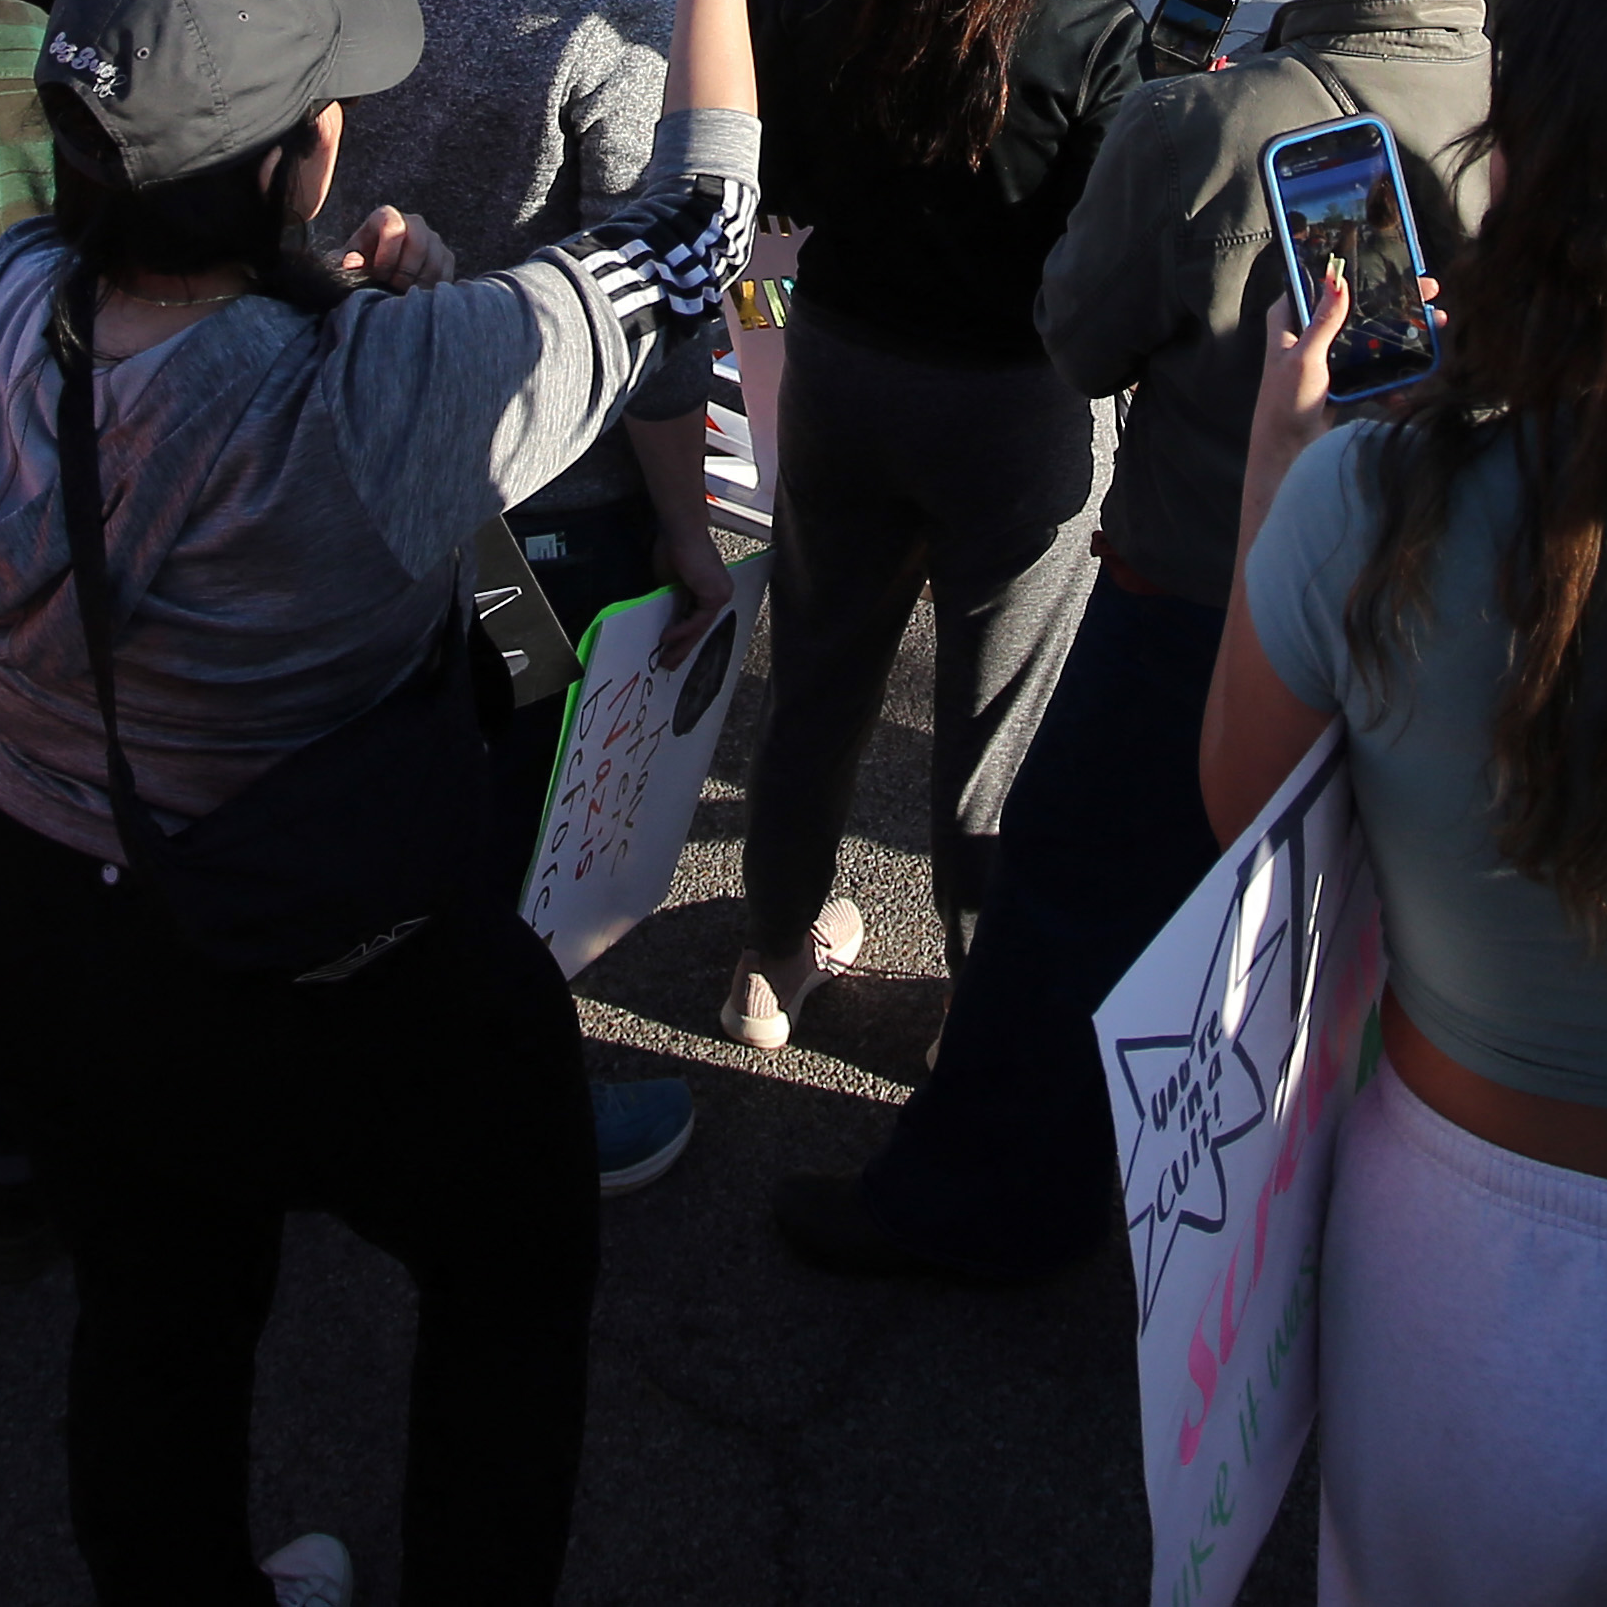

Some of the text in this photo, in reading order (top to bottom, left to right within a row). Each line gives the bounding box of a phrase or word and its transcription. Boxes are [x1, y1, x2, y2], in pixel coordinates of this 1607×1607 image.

[575, 671, 640, 881] Nazis
[1179, 1051, 1223, 1133] in a
